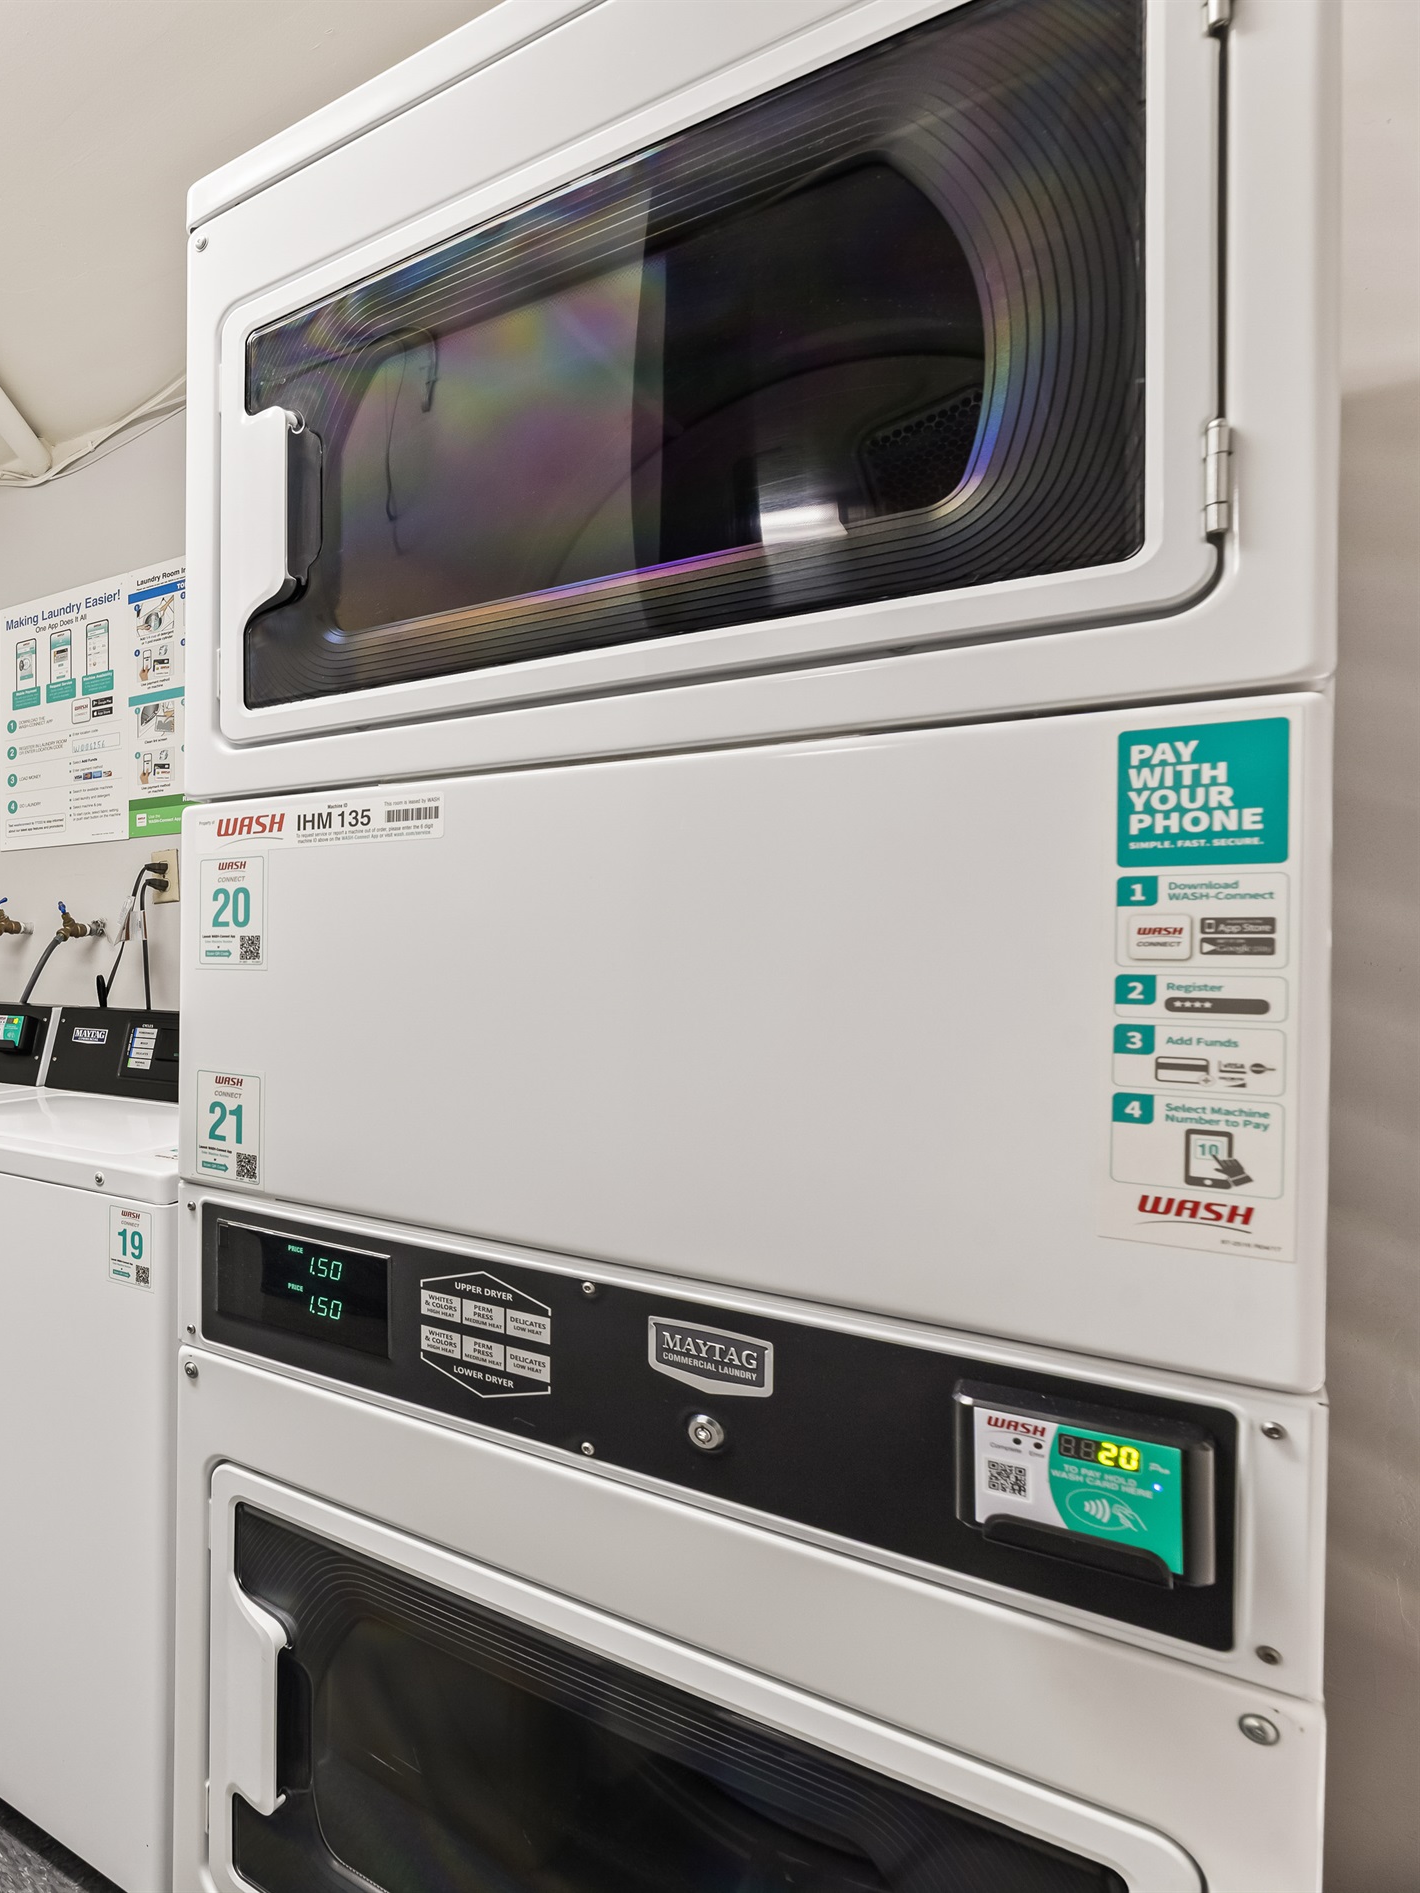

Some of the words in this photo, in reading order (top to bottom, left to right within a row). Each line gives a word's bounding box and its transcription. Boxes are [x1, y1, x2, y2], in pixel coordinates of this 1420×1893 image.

[136, 574, 160, 587] Laundry
[162, 570, 179, 579] Room
[6, 614, 39, 631] Making
[42, 602, 82, 621] Laundry
[85, 589, 121, 609] Easier!
[35, 625, 46, 633] One
[48, 622, 58, 631] App
[60, 618, 74, 626] Does
[1130, 739, 1200, 767] PAY
[10, 776, 15, 784] 3
[1128, 761, 1228, 790] WITH
[1127, 785, 1235, 812] YOUR
[217, 813, 285, 837] WASH
[297, 812, 332, 831] IHM
[338, 808, 372, 828] 135
[1129, 807, 1264, 836] PHONE
[1128, 840, 1175, 850] SIMPLE.
[1176, 838, 1211, 848] FAST.
[1212, 837, 1264, 847] SECURE.
[218, 860, 247, 871] WASH
[217, 875, 246, 883] CONNECT
[1167, 880, 1240, 891] Download
[1129, 884, 1146, 902] 1
[1167, 891, 1275, 902] WASH-Connect
[211, 886, 251, 928] 20
[1136, 926, 1184, 936] WASH
[1218, 924, 1241, 933] App
[1242, 923, 1272, 932] Store
[1135, 940, 1182, 948] CONNECT
[1126, 981, 1145, 999] 2
[1166, 982, 1225, 994] Register
[75, 1029, 105, 1039] MAYTAG
[1125, 1031, 1143, 1049] 3
[1165, 1036, 1193, 1046] Add
[1196, 1036, 1239, 1048] Funds
[215, 1076, 244, 1087] WASH
[214, 1090, 242, 1099] CONNECT
[1124, 1101, 1143, 1118] 4
[1164, 1102, 1207, 1115] Select
[1210, 1106, 1271, 1120] Machine
[208, 1101, 243, 1145] 21
[1164, 1115, 1222, 1127] Number
[1224, 1118, 1240, 1129] to
[1242, 1119, 1271, 1132] Pay
[1197, 1143, 1220, 1157] 10
[121, 1210, 140, 1219] WASH
[1138, 1194, 1255, 1226] WASH
[118, 1228, 143, 1260] 19
[288, 1245, 303, 1254] PRICE
[310, 1257, 342, 1281] 1.50
[288, 1283, 303, 1292] PRICE
[454, 1282, 482, 1294] UPPER
[484, 1288, 513, 1301] DRYER
[428, 1294, 454, 1305] WHITES
[310, 1295, 342, 1320] 1.50
[432, 1302, 457, 1312] COLORS
[474, 1304, 493, 1314] PERM
[473, 1311, 494, 1321] PRESS
[510, 1316, 547, 1330] DELICATES
[465, 1317, 487, 1326] MEDIUM
[488, 1322, 502, 1330] HEAT
[514, 1325, 526, 1333] LOW
[527, 1328, 542, 1336] HEAT
[428, 1330, 454, 1341] WHITES
[427, 1343, 440, 1351] HIGH
[432, 1337, 457, 1349] COLORS
[474, 1341, 493, 1351] PERM
[473, 1348, 493, 1358] PRESS
[662, 1331, 758, 1370] MAYTAG
[465, 1353, 487, 1363] MEDIUM
[488, 1359, 502, 1367] HEAT
[510, 1354, 546, 1368] DELICATES
[663, 1351, 716, 1372] COMMERCIAL
[719, 1365, 757, 1381] LAUNDRY
[513, 1362, 526, 1371] LOW
[527, 1366, 542, 1374] HEAT
[453, 1365, 483, 1380] LOWER
[485, 1373, 514, 1388] DRYER
[987, 1416, 1046, 1437] WASH
[1098, 1441, 1140, 1471] 20
[1063, 1464, 1078, 1473] TO
[1081, 1468, 1101, 1478] PAY
[1104, 1473, 1137, 1487] HOLD
[1051, 1469, 1083, 1483] WASH
[1085, 1476, 1119, 1490] CARD
[1121, 1485, 1153, 1499] HERE
